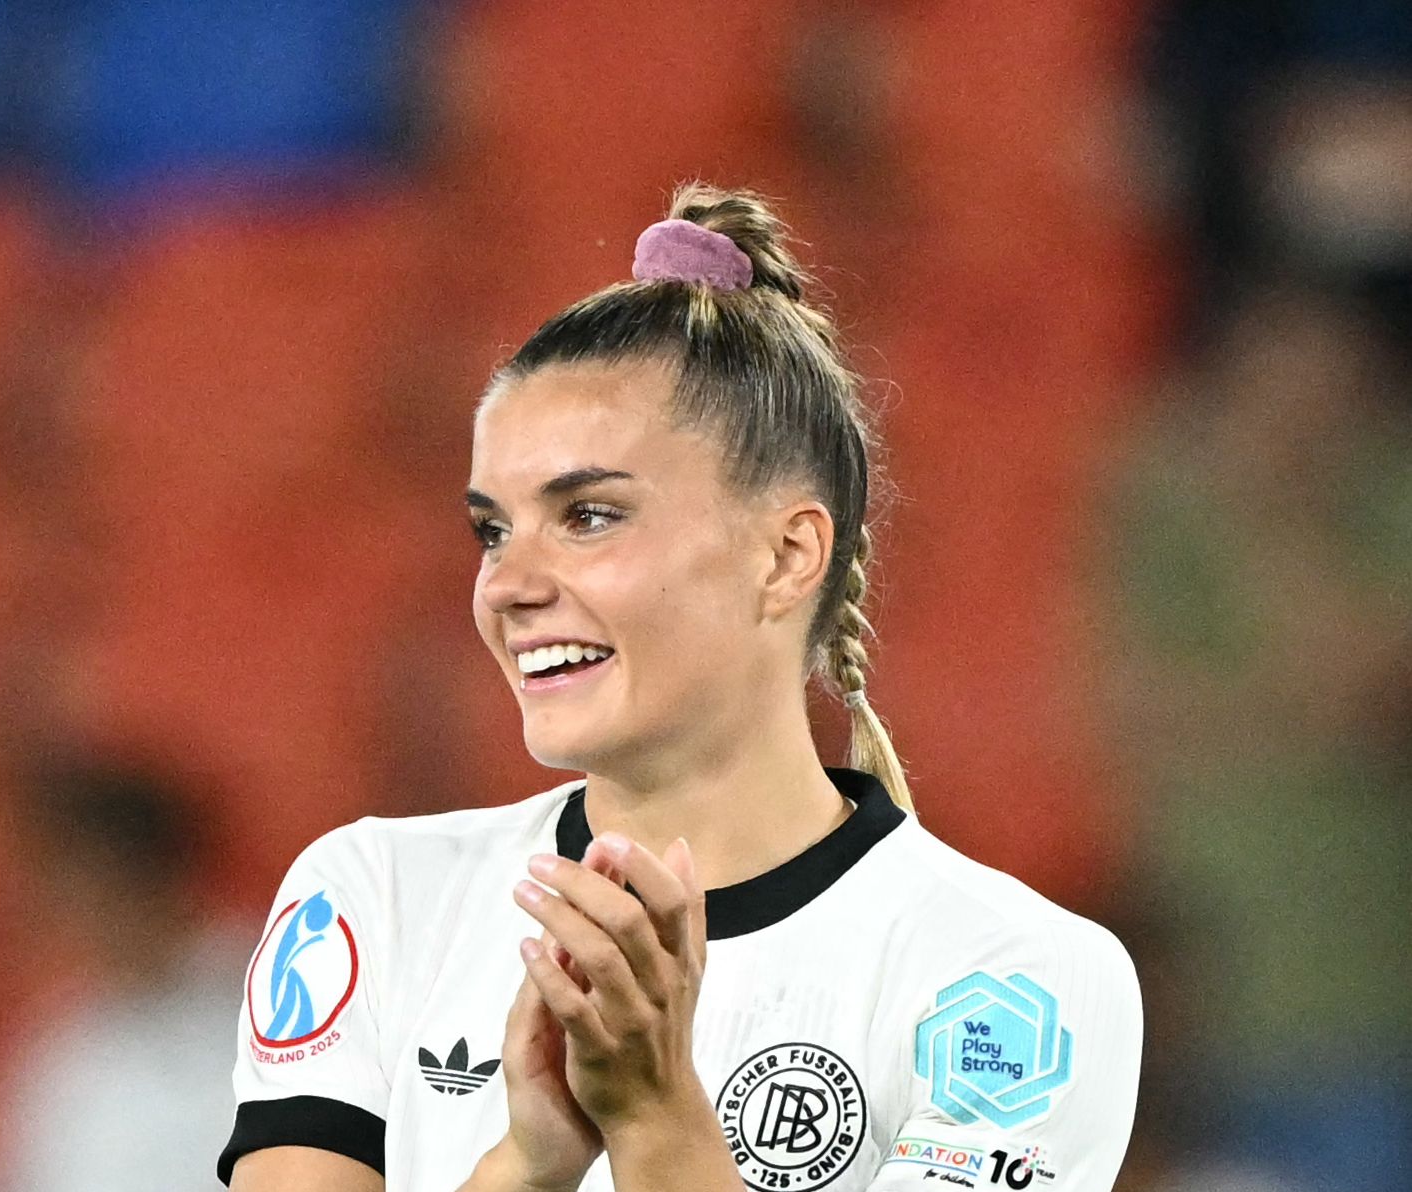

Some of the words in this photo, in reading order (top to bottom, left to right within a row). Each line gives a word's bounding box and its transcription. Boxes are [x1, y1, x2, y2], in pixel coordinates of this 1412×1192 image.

[963, 1020, 991, 1036] We
[310, 1030, 341, 1056] 2025
[961, 1038, 1002, 1059] Play
[961, 1057, 1024, 1080] Strong
[723, 1054, 779, 1167] DEUTSCHER
[759, 1168, 791, 1188] 125
